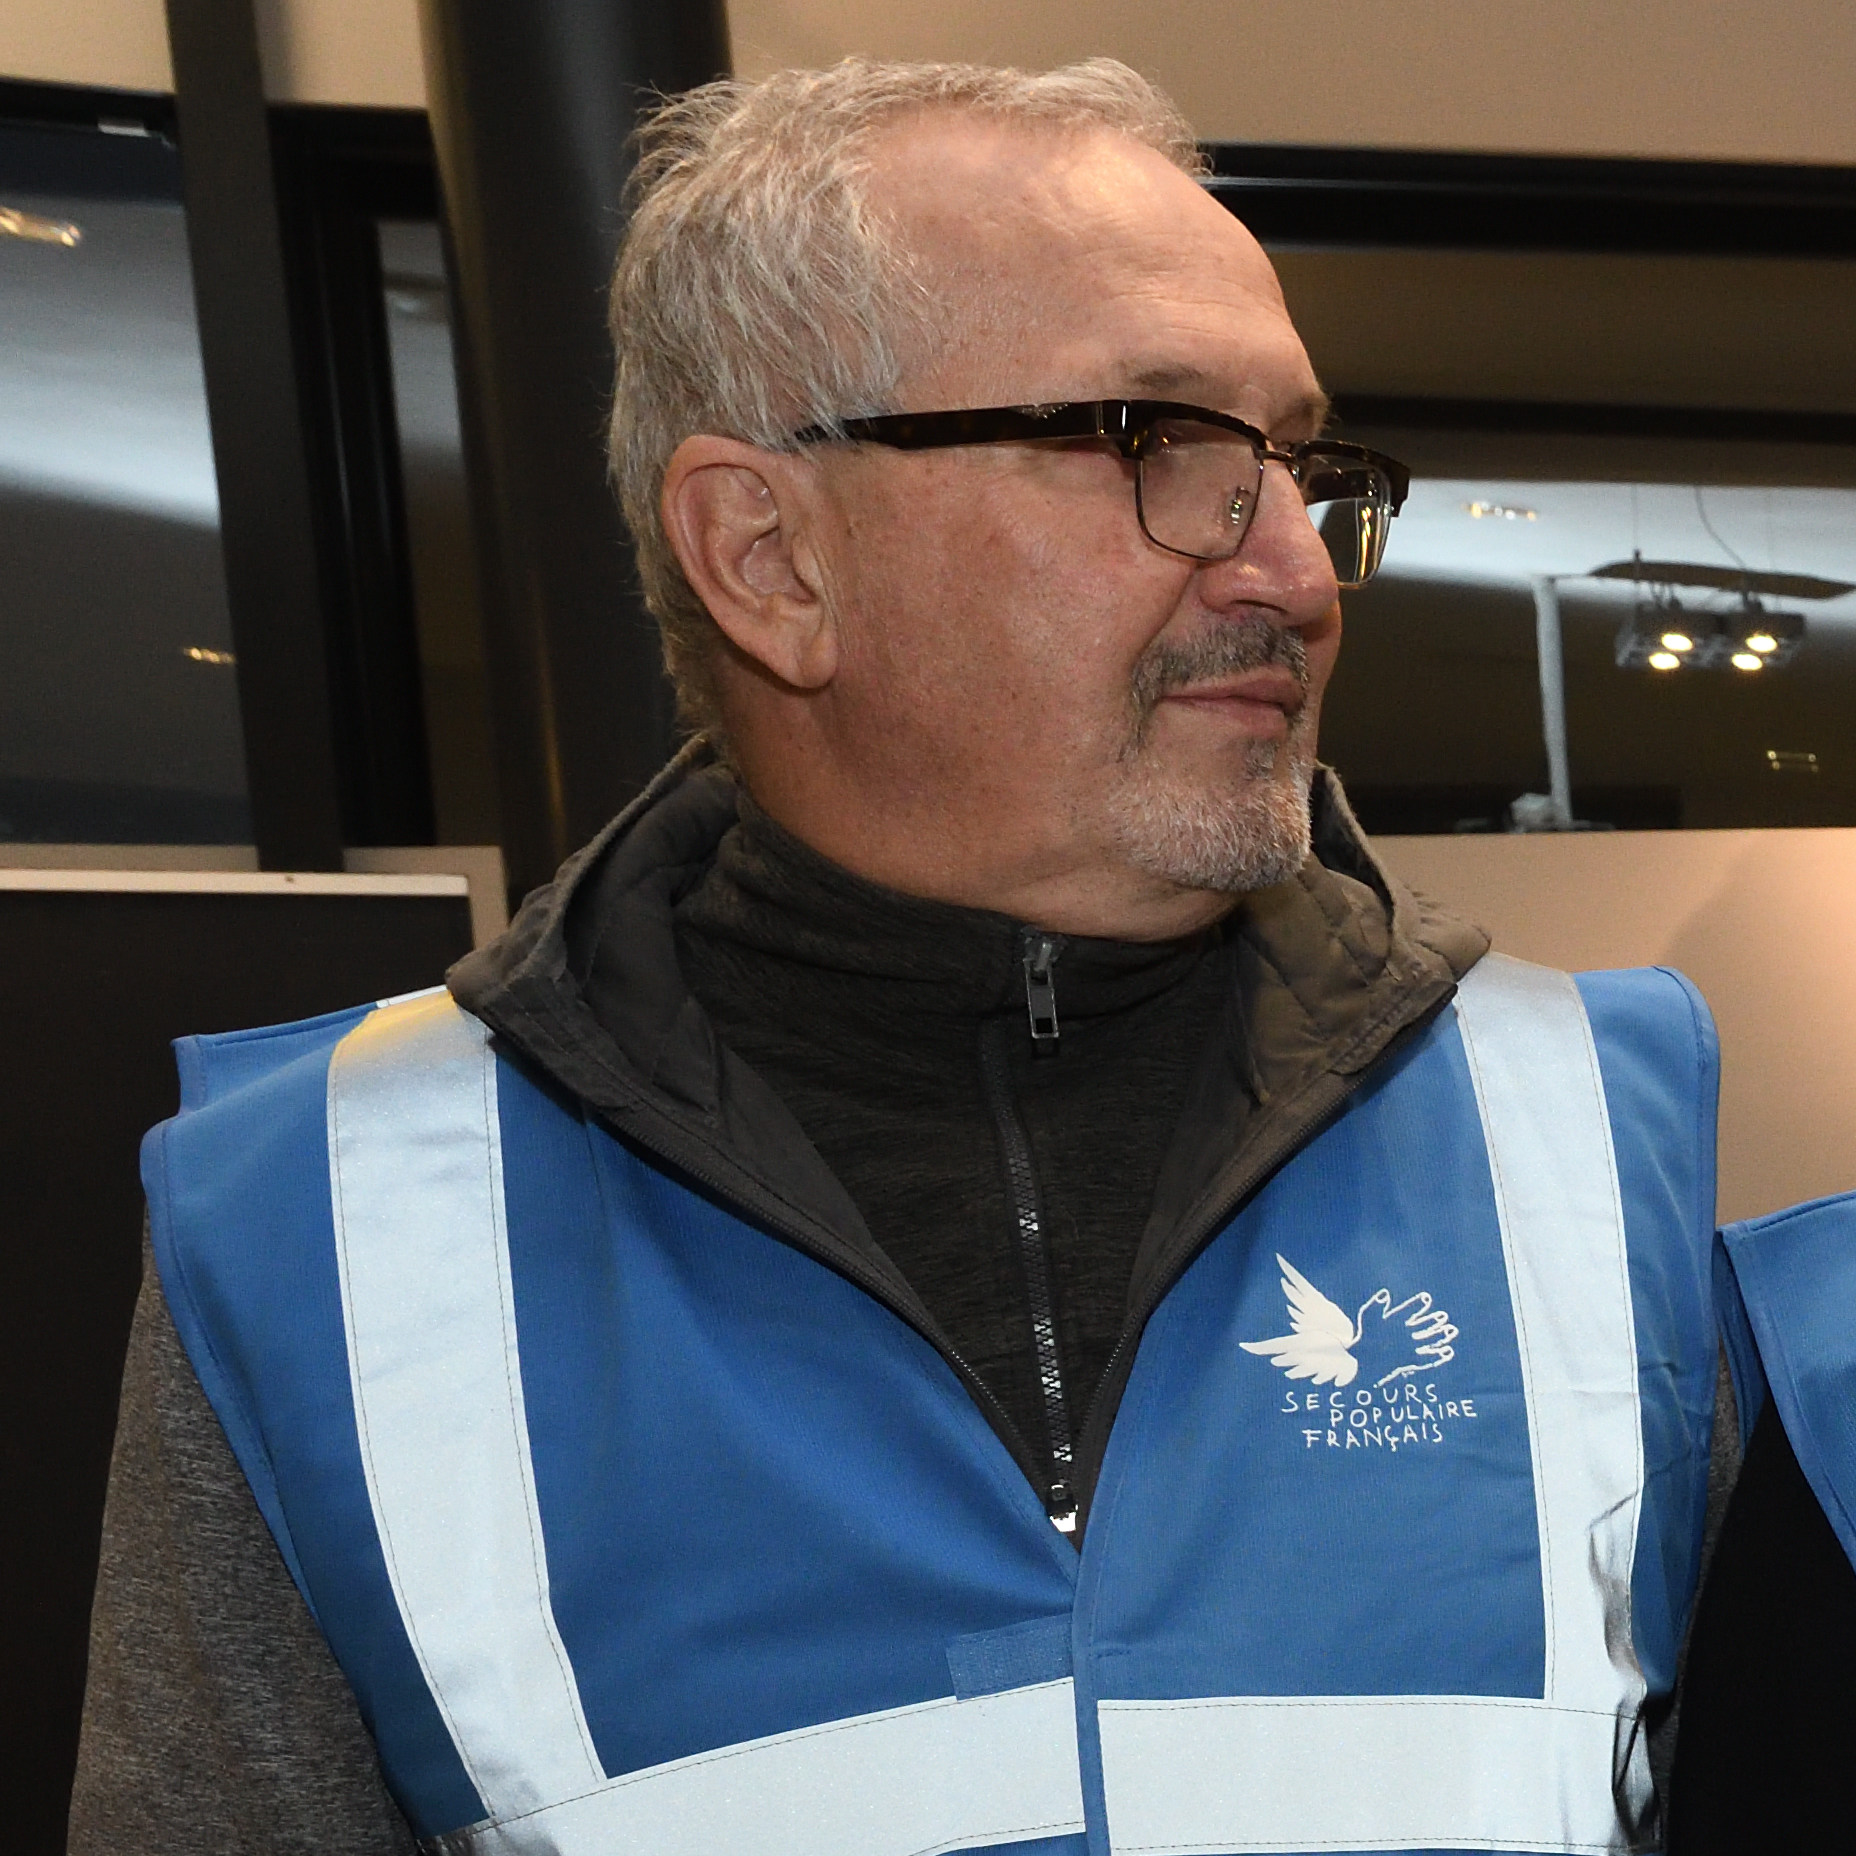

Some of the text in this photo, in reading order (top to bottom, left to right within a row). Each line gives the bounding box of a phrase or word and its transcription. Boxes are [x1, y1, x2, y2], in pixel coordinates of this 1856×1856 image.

[1281, 1383, 1438, 1413] SECOURS
[1330, 1399, 1477, 1427] POPULAIRE
[1302, 1424, 1443, 1451] FRANÇAIS
